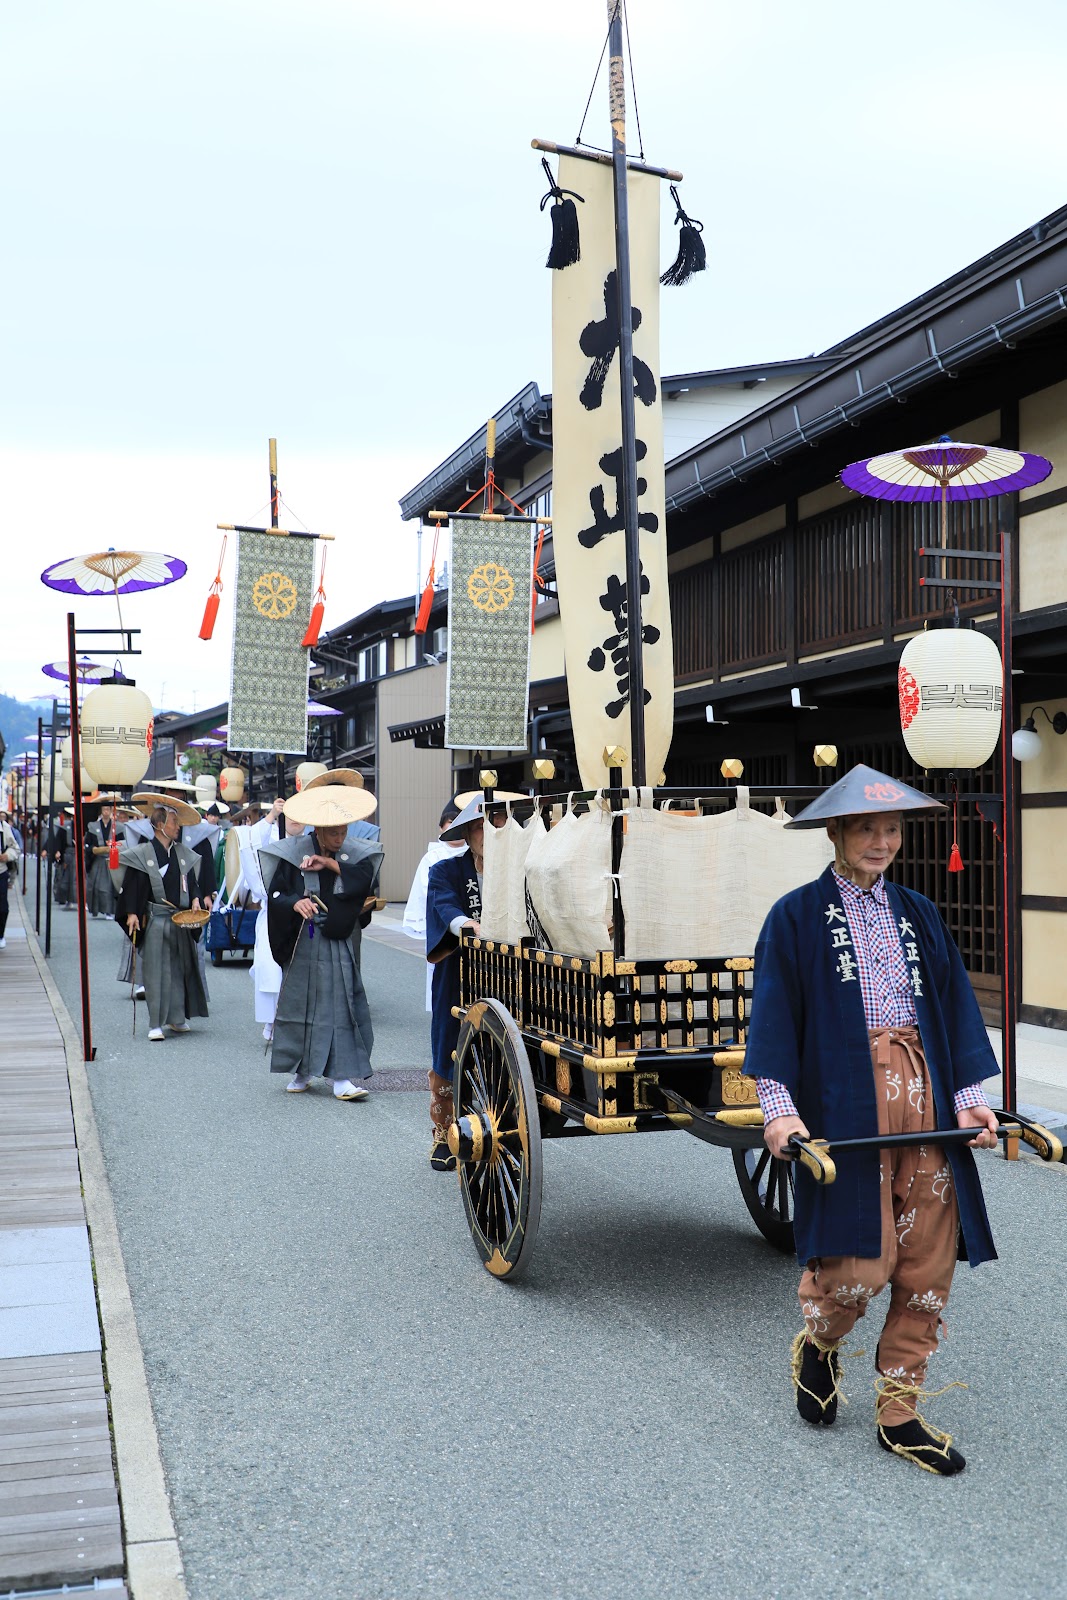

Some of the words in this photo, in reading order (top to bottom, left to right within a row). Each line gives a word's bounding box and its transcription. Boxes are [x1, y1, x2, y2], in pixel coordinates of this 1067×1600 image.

[824, 903, 858, 982] 大正臺
[898, 916, 923, 997] 大正臺
